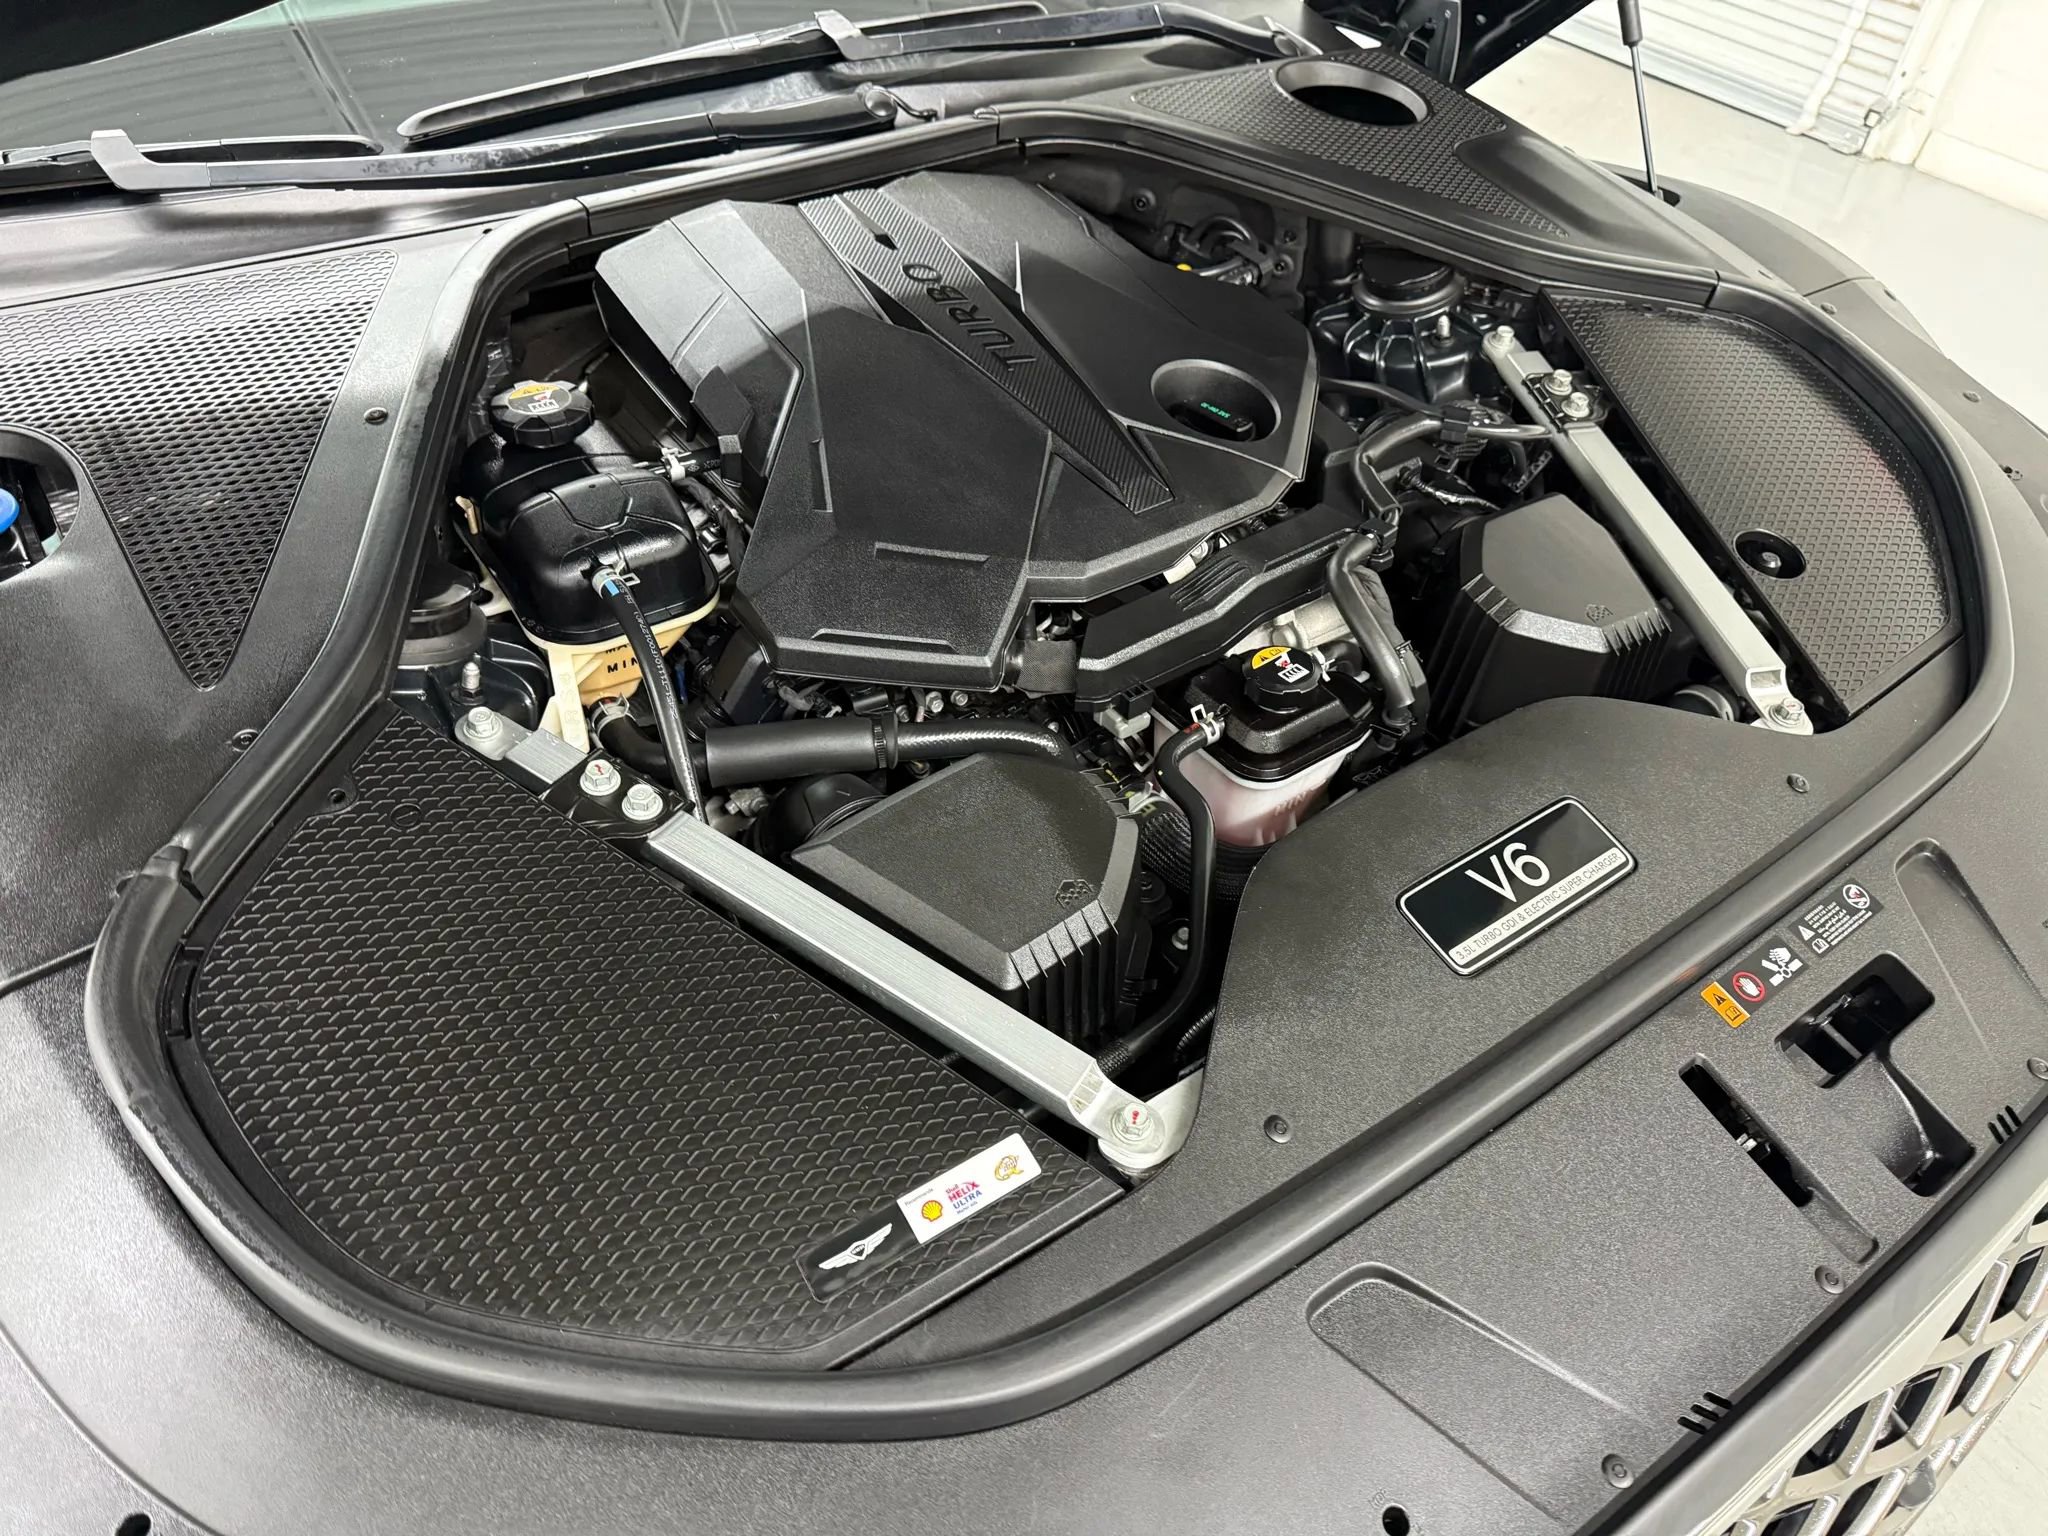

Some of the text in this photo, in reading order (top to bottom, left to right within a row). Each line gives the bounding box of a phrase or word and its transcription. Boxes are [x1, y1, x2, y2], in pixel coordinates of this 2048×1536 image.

[901, 263, 1037, 372] TURBO
[1464, 842, 1550, 902] V6
[1473, 928, 1502, 948] TURBO
[1501, 917, 1518, 931] GDI
[1518, 911, 1527, 922] &
[1524, 890, 1561, 916] ELECTRIC
[1559, 876, 1585, 895] SUPER
[1582, 852, 1622, 879] CHARGER
[948, 1182, 980, 1202] HELIX
[953, 1190, 982, 1209] ULTRA
